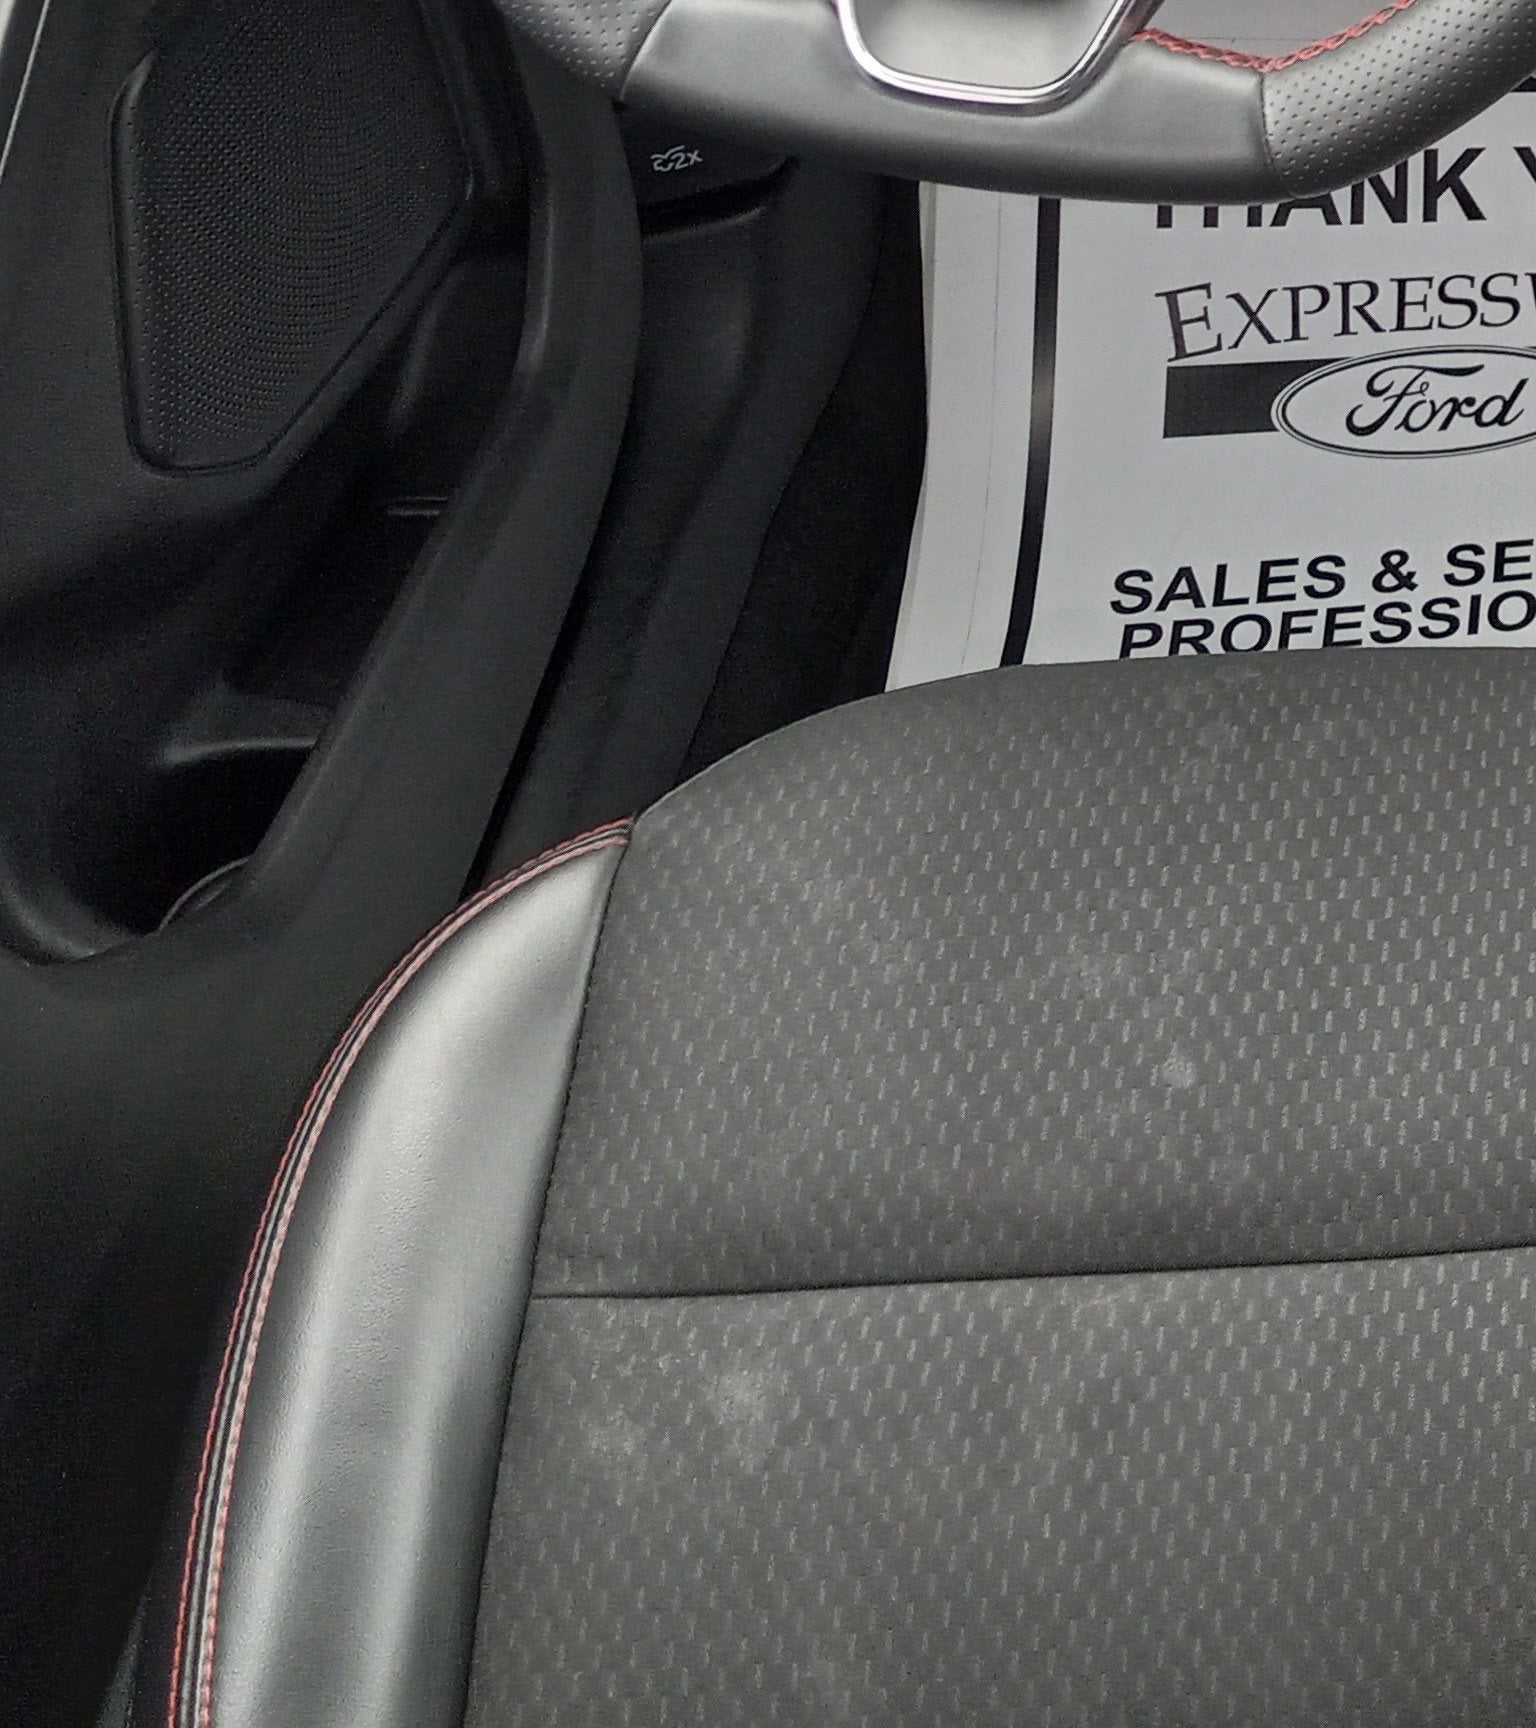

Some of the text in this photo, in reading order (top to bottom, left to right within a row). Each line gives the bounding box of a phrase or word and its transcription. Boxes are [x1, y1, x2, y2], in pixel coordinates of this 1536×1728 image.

[1344, 364, 1531, 439] Ford
[1109, 554, 1347, 616] SALES
[1370, 548, 1419, 594] &
